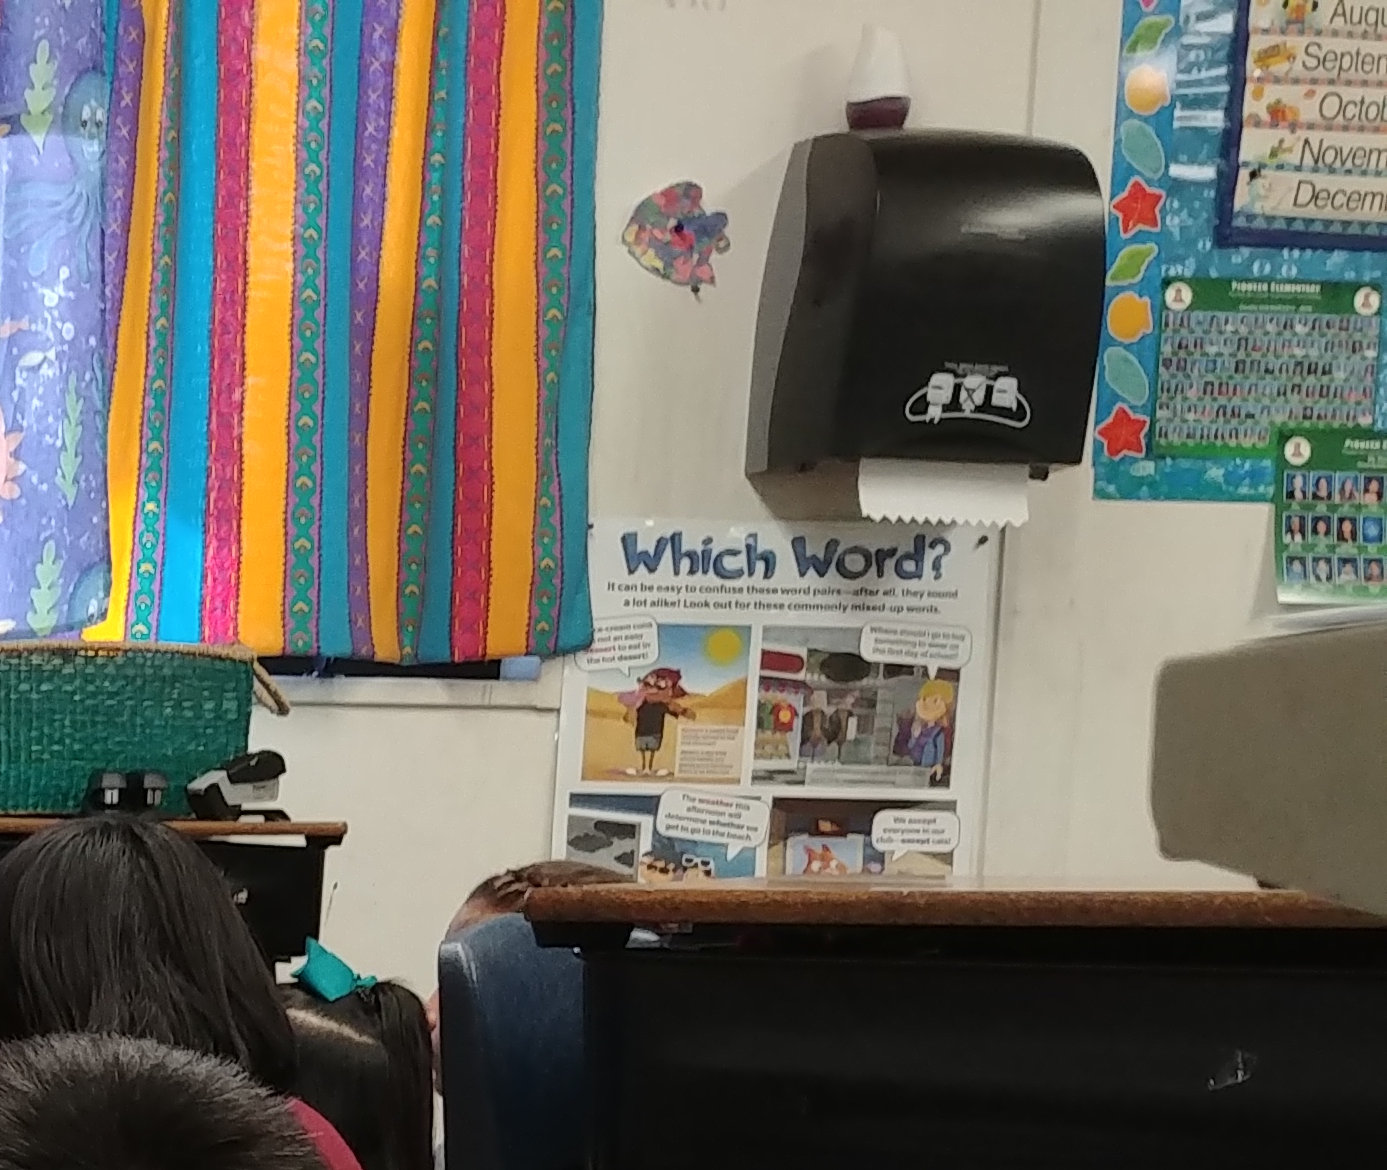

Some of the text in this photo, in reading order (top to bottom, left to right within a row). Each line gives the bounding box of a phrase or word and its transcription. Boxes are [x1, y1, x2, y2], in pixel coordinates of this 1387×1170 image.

[1292, 179, 1387, 212] Decem
[621, 530, 952, 581] Which Word?
